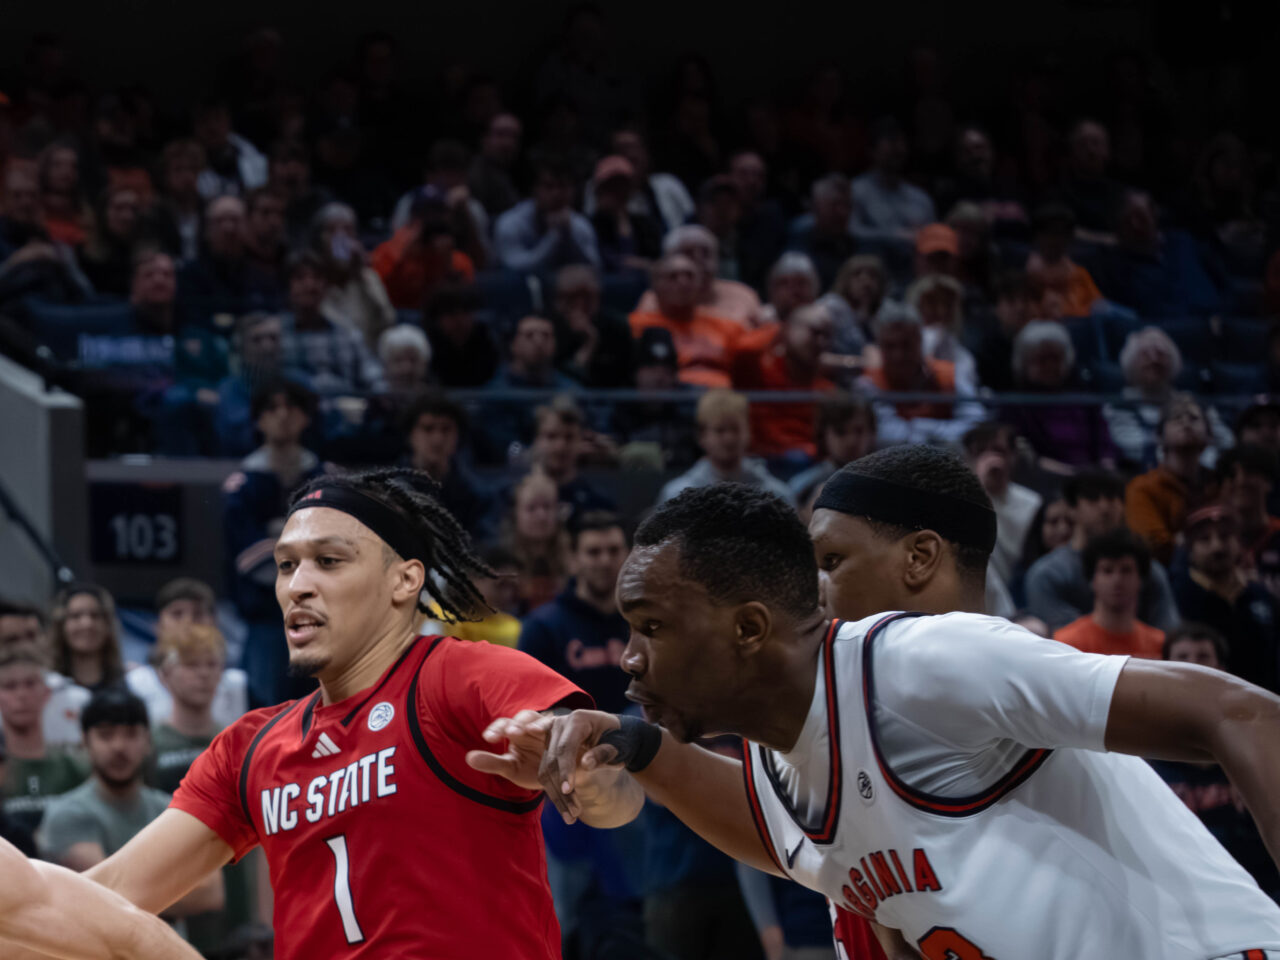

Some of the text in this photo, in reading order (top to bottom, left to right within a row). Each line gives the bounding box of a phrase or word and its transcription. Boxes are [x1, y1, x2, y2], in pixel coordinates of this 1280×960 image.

[111, 514, 177, 559] 103
[260, 745, 398, 836] NC STATE
[325, 833, 366, 945] 1
[842, 848, 943, 920] RGINIA
